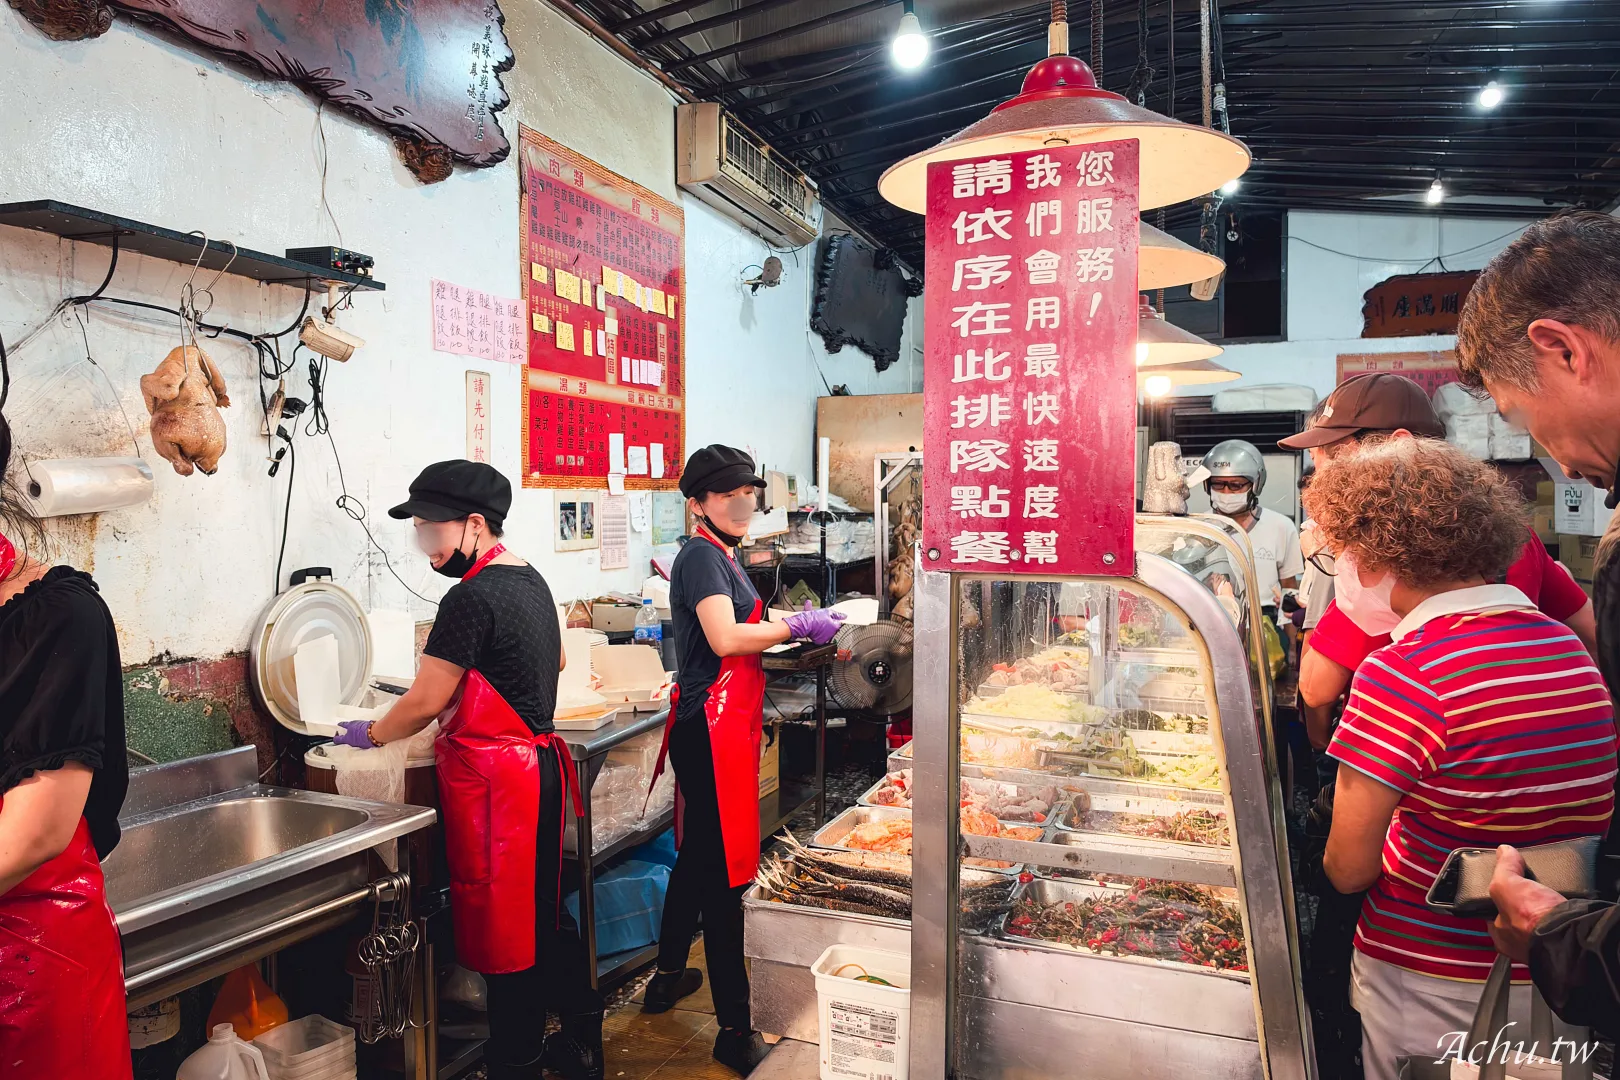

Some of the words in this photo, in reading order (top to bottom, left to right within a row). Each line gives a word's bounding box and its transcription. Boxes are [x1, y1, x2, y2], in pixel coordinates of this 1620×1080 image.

[549, 158, 584, 188] 肉類
[473, 378, 485, 462] 請先付款
[949, 159, 1013, 565] 請依序在此排隊點餐
[1022, 155, 1062, 564] 我們會用最快速度幫
